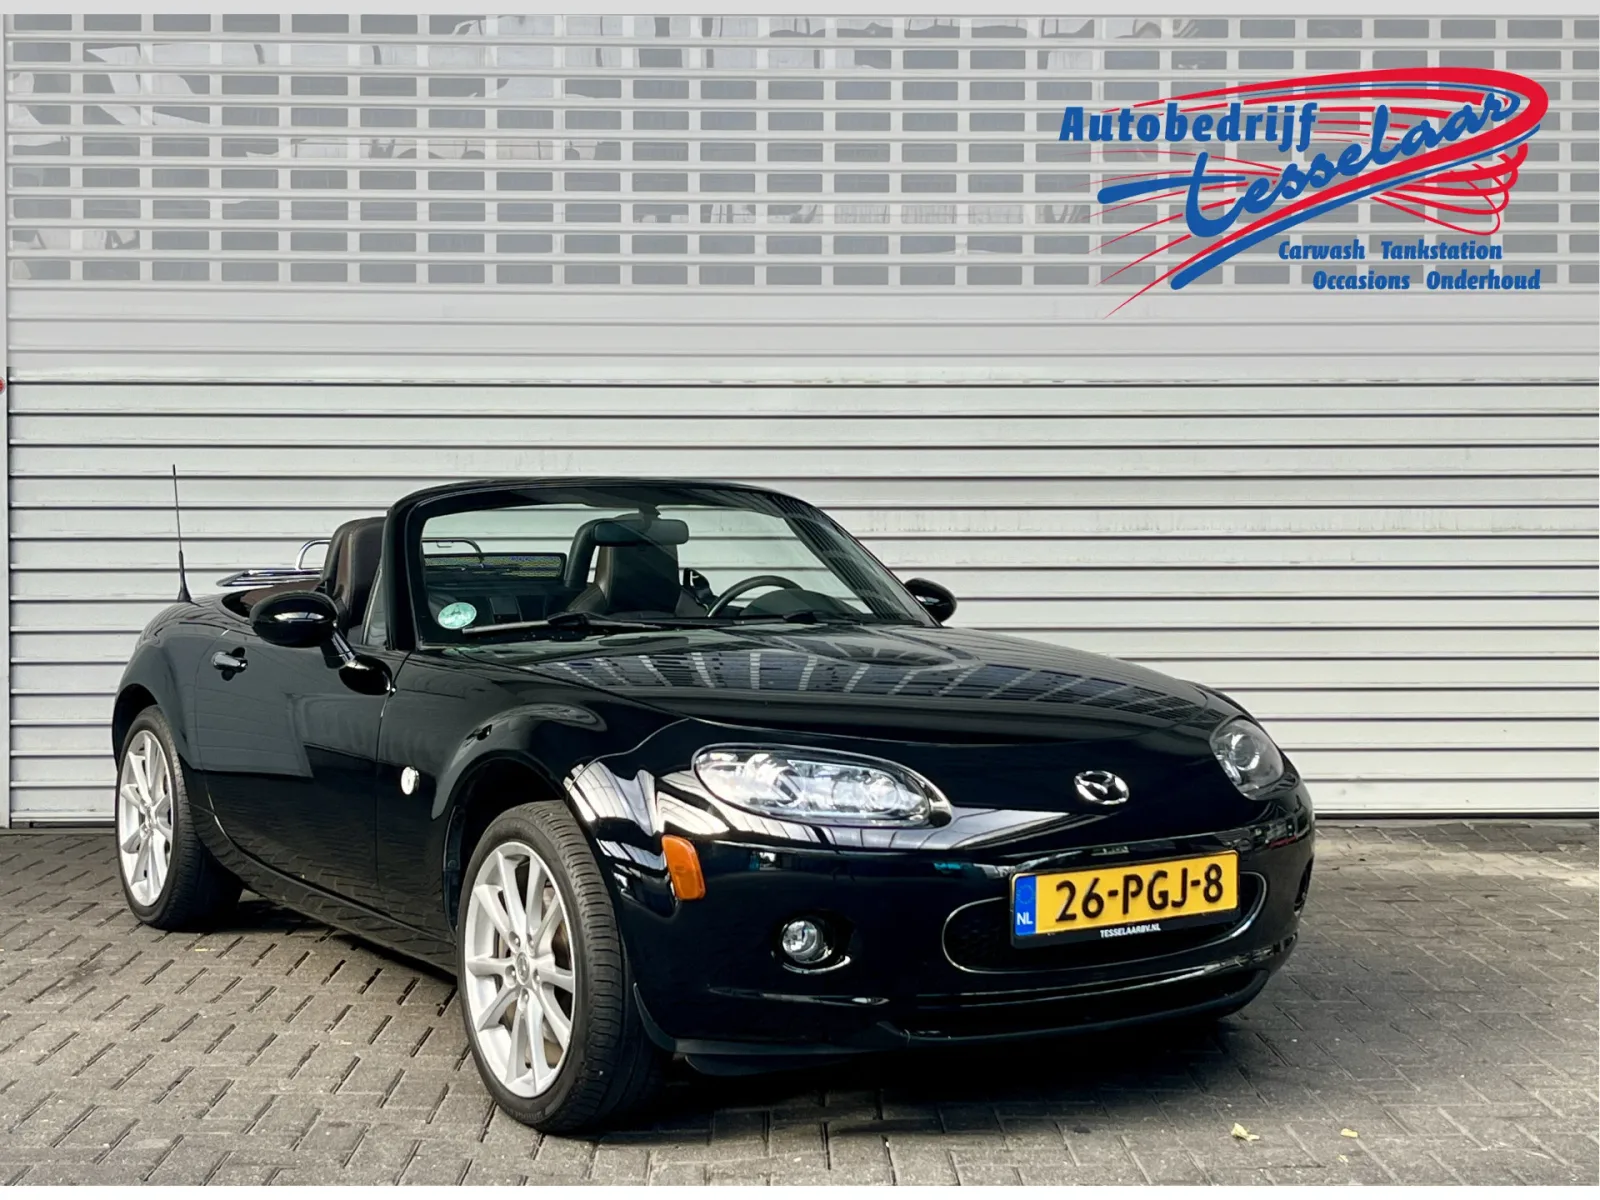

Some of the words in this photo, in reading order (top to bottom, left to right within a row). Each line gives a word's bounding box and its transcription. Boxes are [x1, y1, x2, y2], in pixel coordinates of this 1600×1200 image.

[1054, 862, 1224, 922] 26-PGJ-8
[1016, 911, 1034, 926] NL
[1100, 922, 1162, 939] TESSELAARBV.NL
